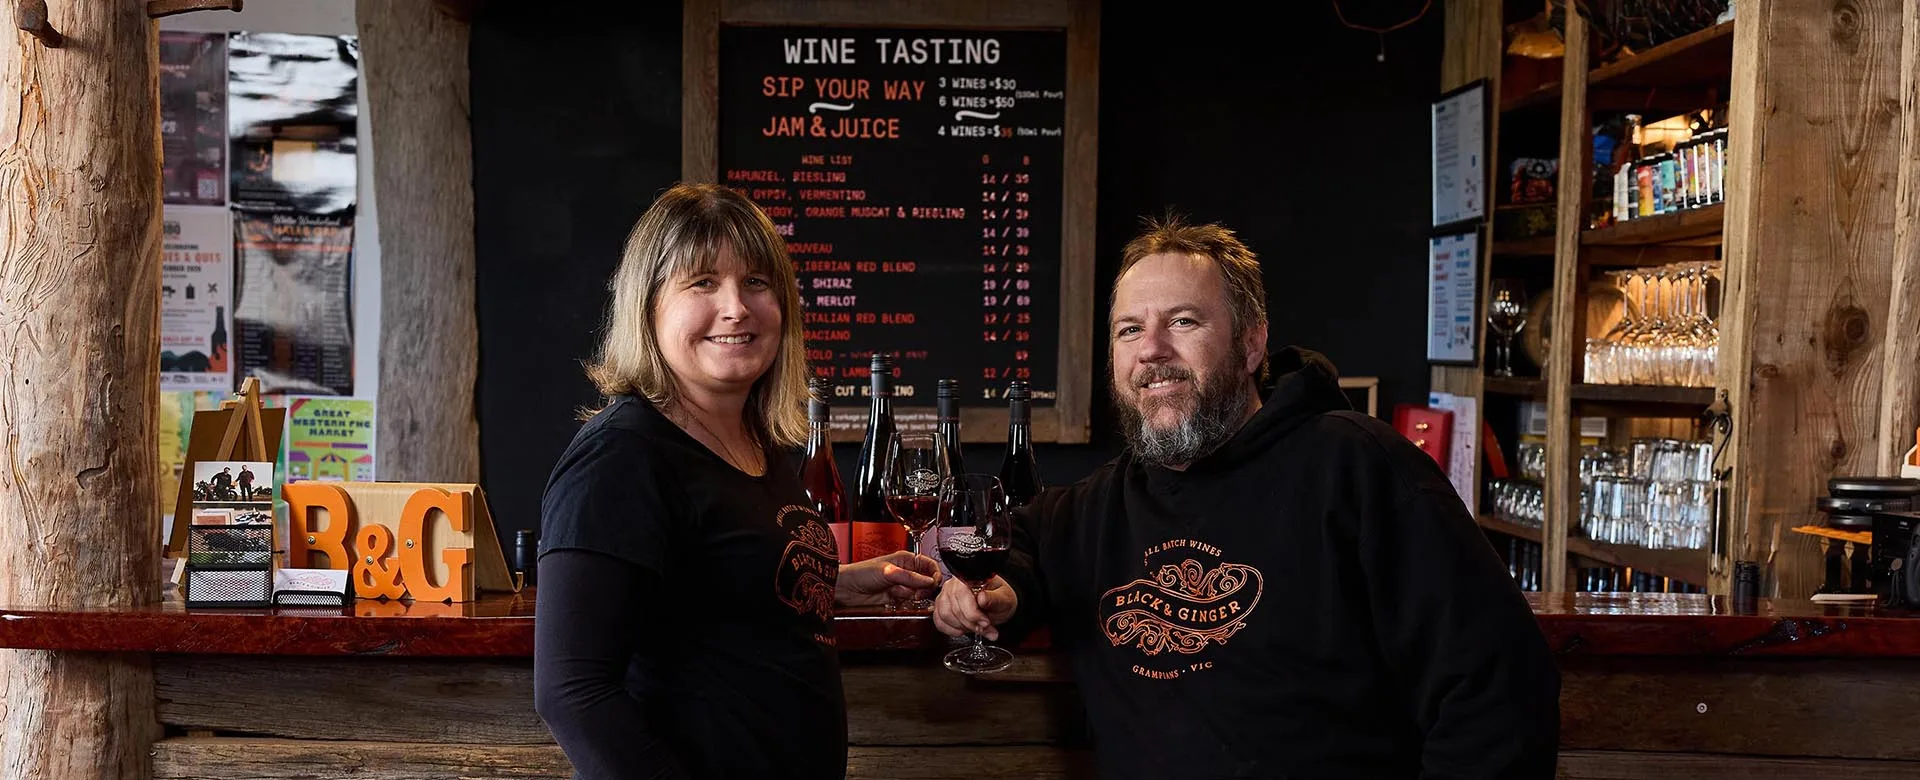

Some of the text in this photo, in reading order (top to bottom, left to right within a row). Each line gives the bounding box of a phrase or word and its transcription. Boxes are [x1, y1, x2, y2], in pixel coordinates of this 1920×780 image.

[783, 38, 1001, 65] WINE TASTING
[762, 76, 925, 101] SIP YOUR WAY
[937, 76, 947, 88] 3
[938, 95, 947, 107] 6
[762, 116, 900, 139] JAM & JUICE
[937, 125, 946, 137] 4
[801, 154, 853, 166] WINE LIST
[792, 171, 846, 183] RIESLING
[800, 188, 866, 201] VERMENTINO
[804, 206, 846, 219] ORANGE
[850, 207, 890, 219] MUSCAT
[895, 207, 907, 220] &
[911, 207, 966, 220] RIESLING
[786, 242, 833, 255] NOUVEAU
[855, 261, 877, 273] RED
[881, 261, 917, 274] BLEND
[811, 277, 854, 290] SHIRAZ
[815, 295, 858, 308] MERLOT
[803, 311, 916, 325] ITALIAN RED BLEND
[803, 329, 851, 341] RACIANO
[835, 385, 915, 398] CUT RIING
[313, 408, 352, 418] GREAT
[293, 417, 346, 427] WESTERN
[309, 428, 355, 438] MARKET
[1162, 538, 1187, 551] BATCH
[1188, 539, 1223, 558] WINES
[1115, 590, 1242, 624] BLACK & GINGER
[1131, 660, 1215, 681] GRAMPIANS VIC
